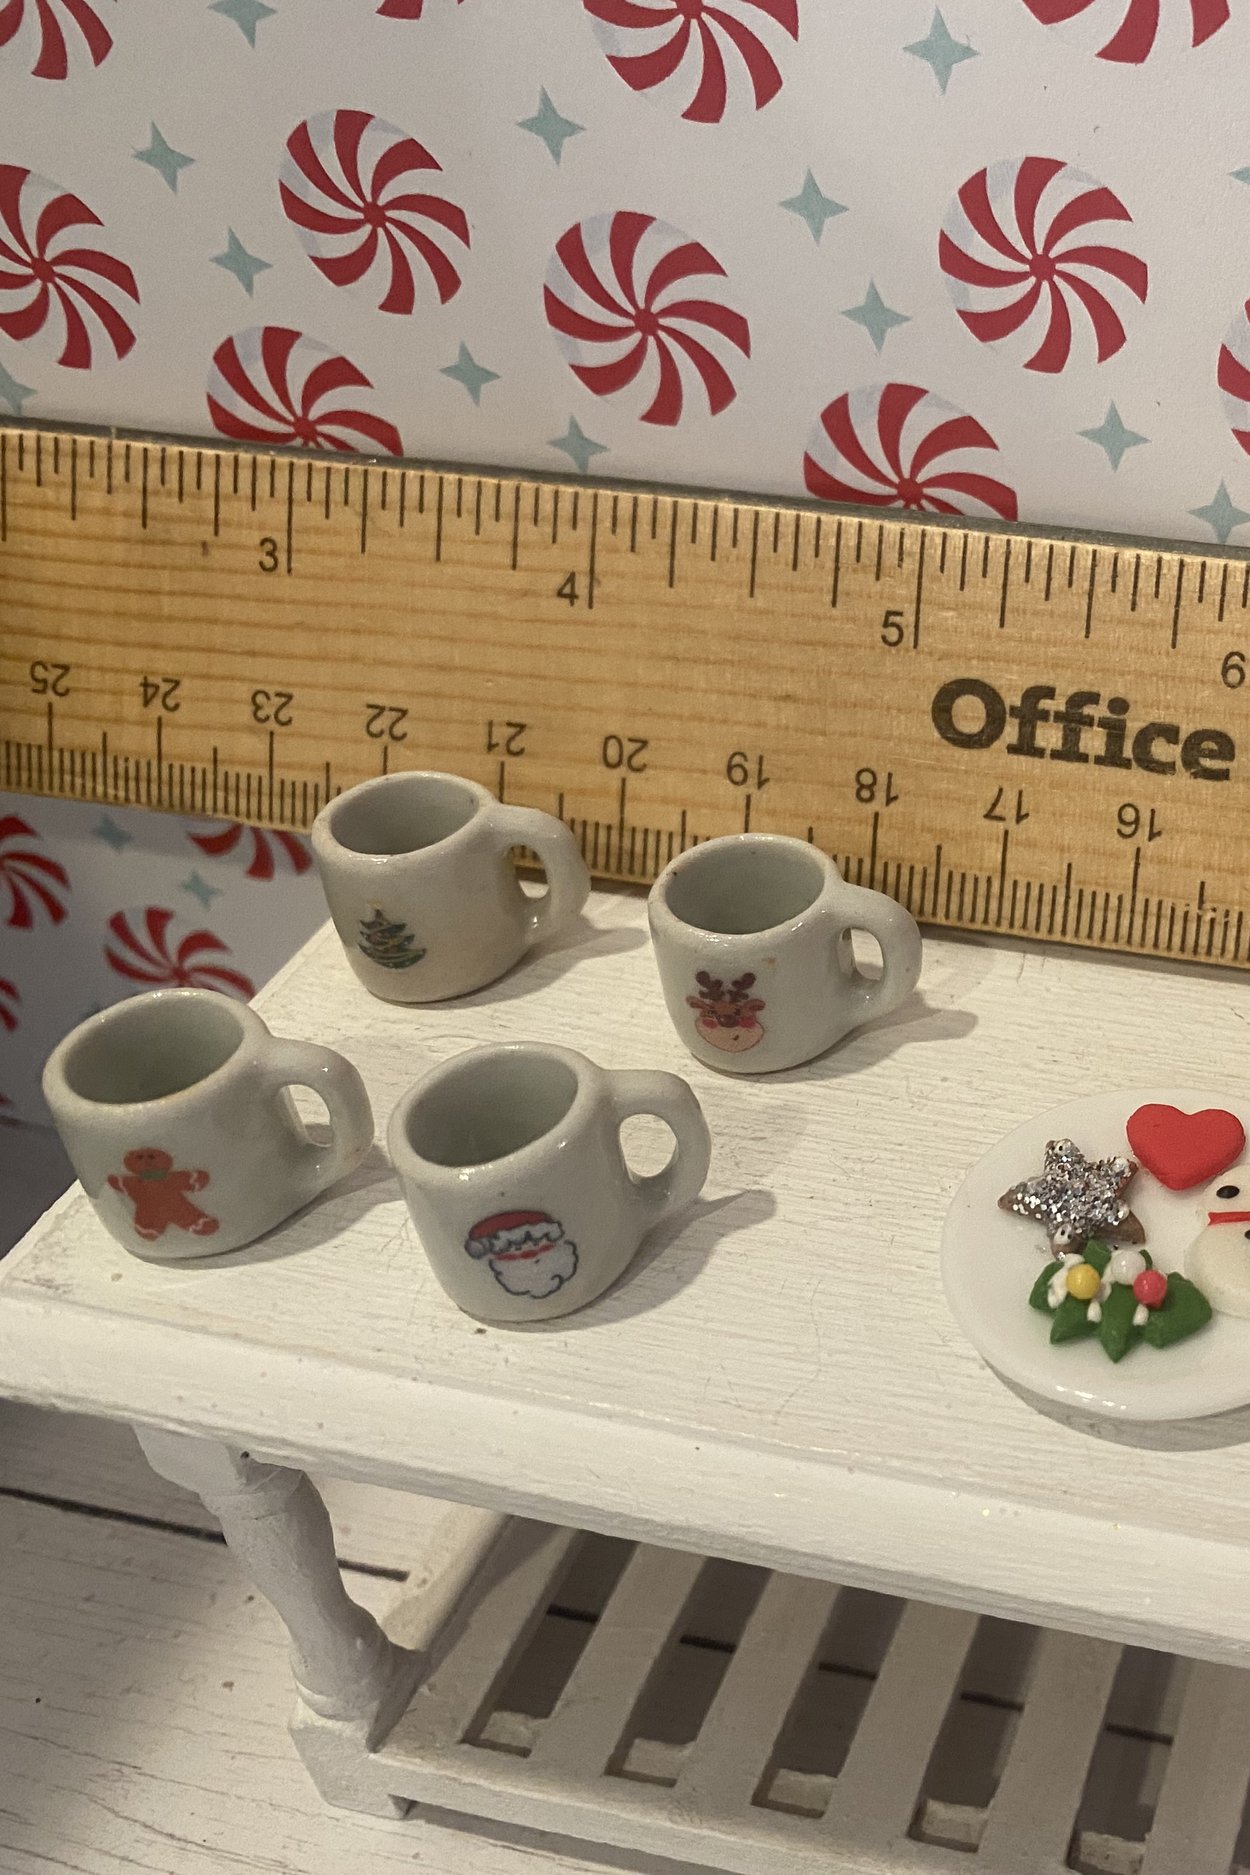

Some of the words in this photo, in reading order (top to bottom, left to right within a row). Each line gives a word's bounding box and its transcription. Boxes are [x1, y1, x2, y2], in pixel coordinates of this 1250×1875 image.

[258, 538, 280, 575] 3
[556, 573, 580, 606] 4
[880, 610, 905, 647] 5
[1221, 651, 1247, 689] 6
[29, 660, 72, 698] 25
[138, 676, 182, 712] 24
[250, 689, 295, 727] 23
[364, 703, 409, 741] 22
[486, 720, 528, 757] 21
[931, 677, 1237, 781] Office
[602, 735, 649, 773] 20
[726, 751, 771, 791] 19
[855, 767, 899, 807] 18
[982, 786, 1030, 825] 17
[1116, 803, 1163, 843] 16
